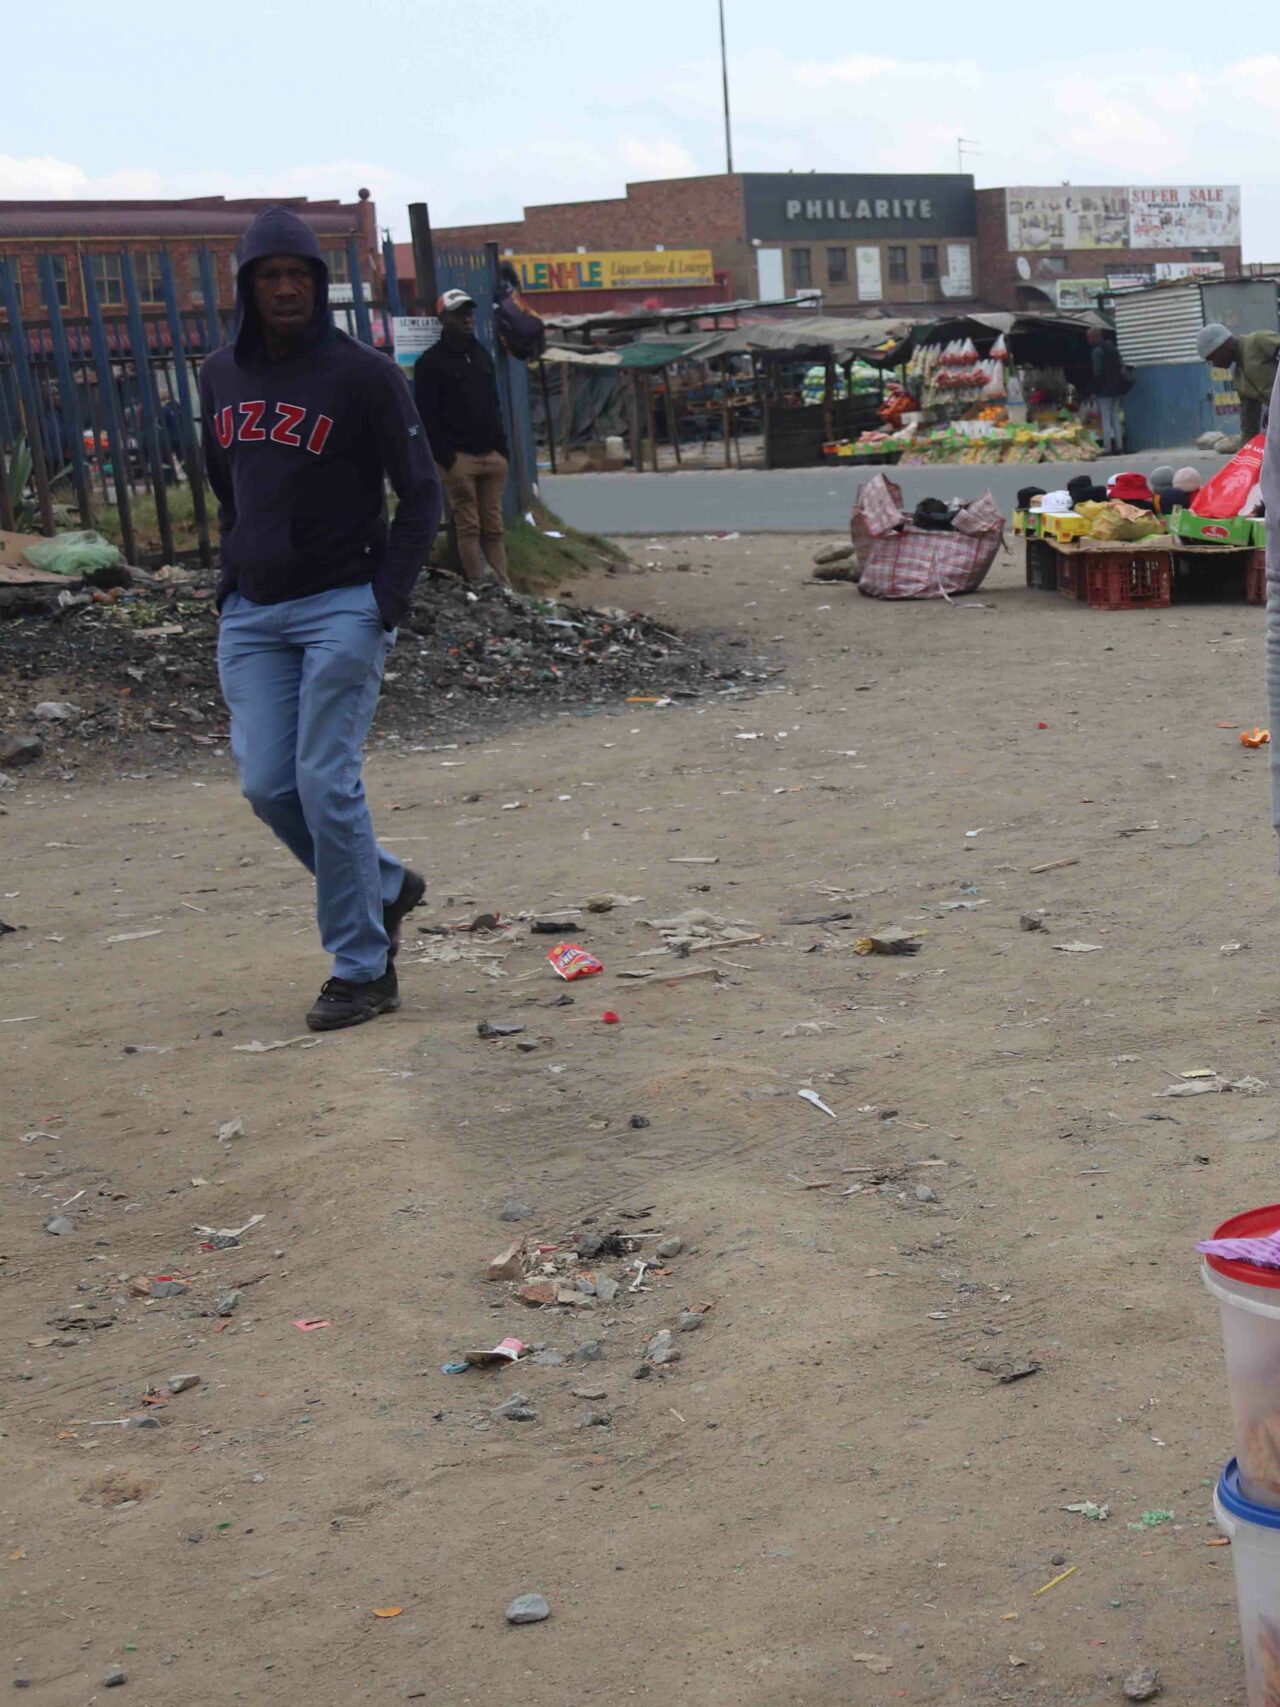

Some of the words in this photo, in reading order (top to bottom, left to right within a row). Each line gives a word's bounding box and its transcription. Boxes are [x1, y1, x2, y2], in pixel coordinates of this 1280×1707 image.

[1132, 189, 1178, 203] SUPER
[1190, 188, 1224, 202] SALE
[785, 199, 932, 220] PHILARITE
[610, 261, 641, 278] Liquor
[643, 260, 667, 274] Store
[677, 259, 712, 275] Lounge
[213, 400, 334, 455] UZZI
